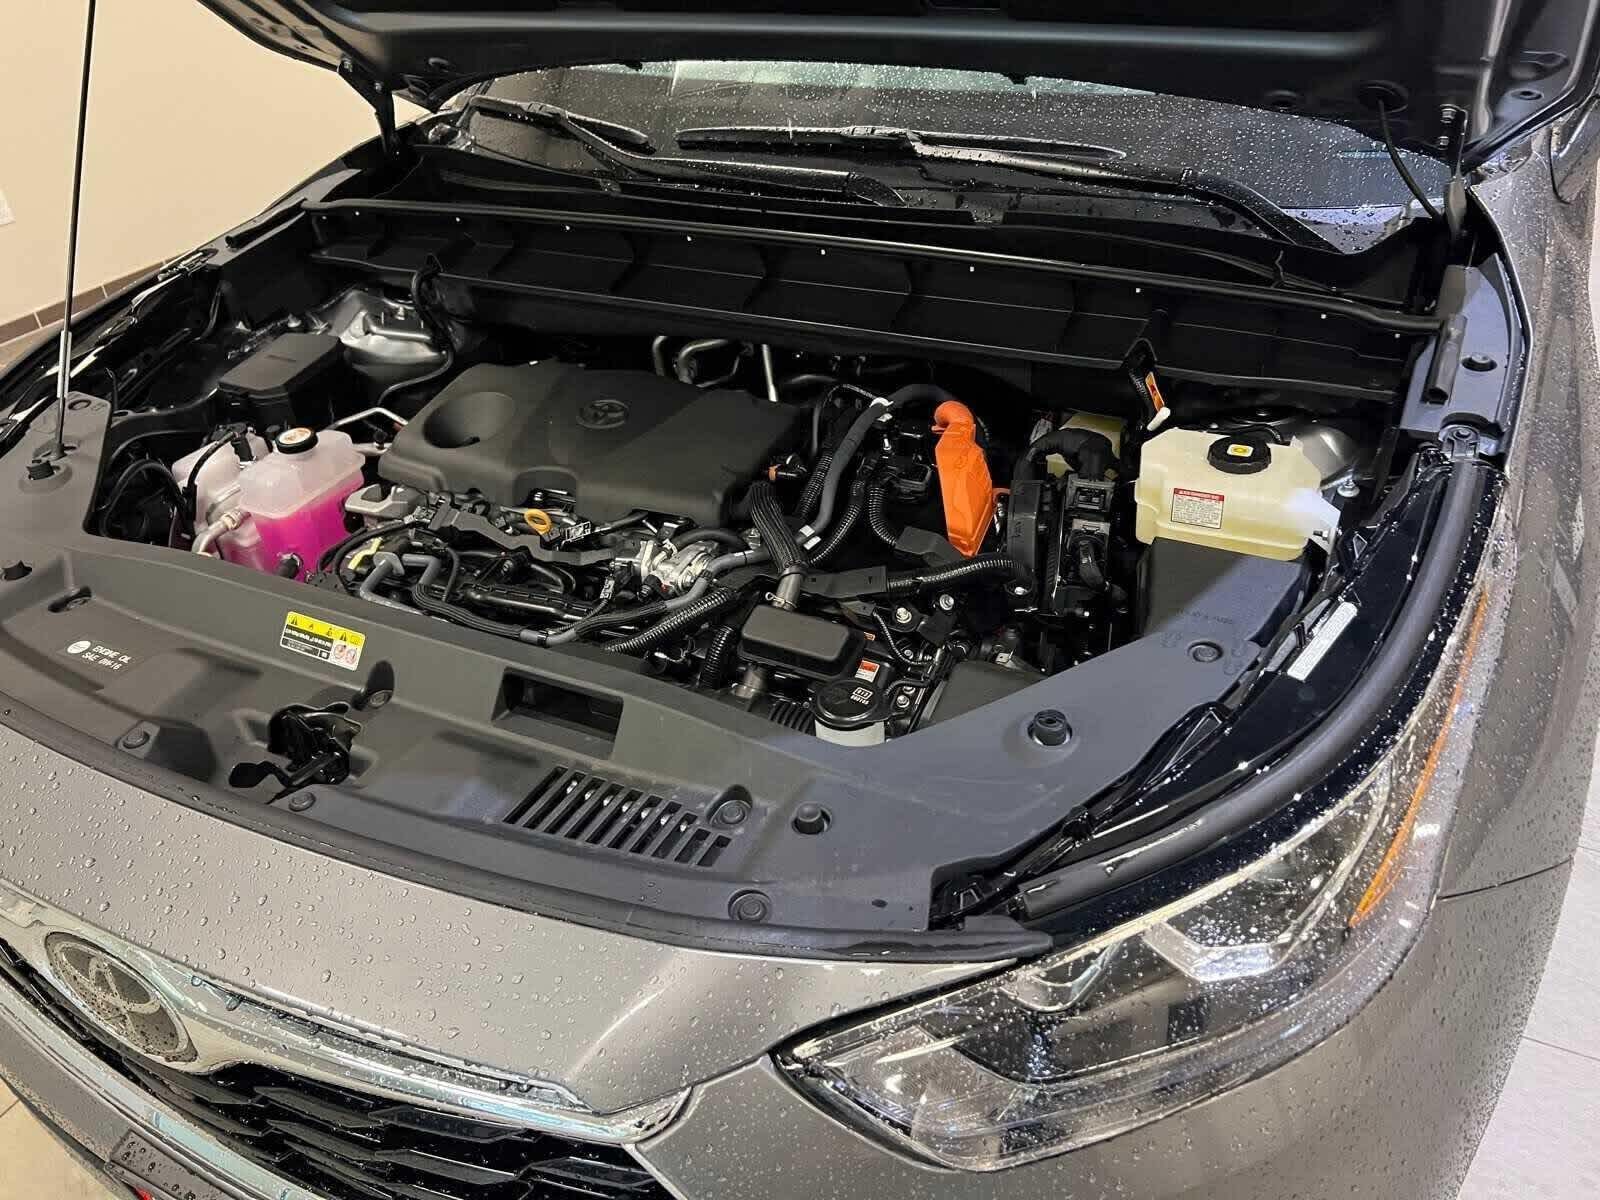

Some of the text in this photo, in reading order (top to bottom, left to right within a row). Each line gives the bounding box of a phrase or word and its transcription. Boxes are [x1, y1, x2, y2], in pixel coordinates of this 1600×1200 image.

[82, 652, 100, 661] SAE
[92, 645, 120, 658] ENGINE
[118, 655, 131, 663] OIL
